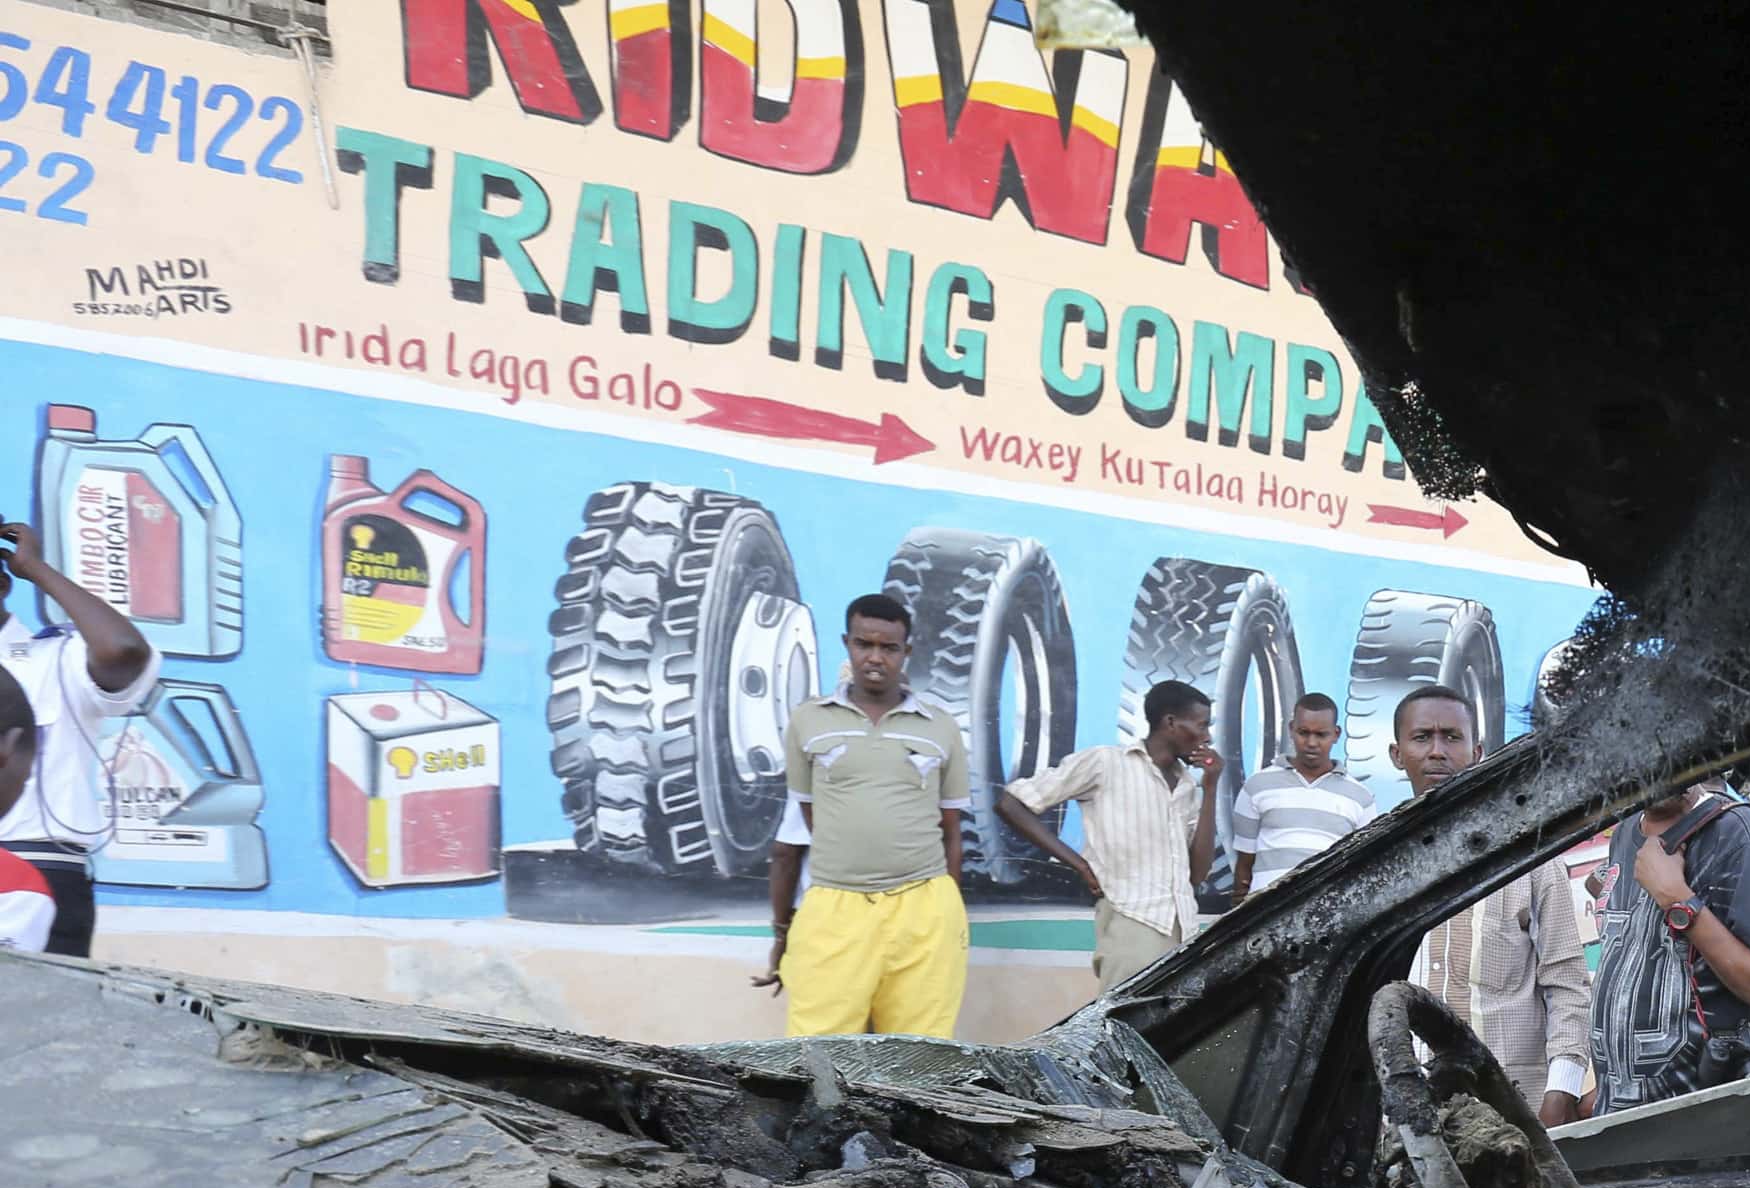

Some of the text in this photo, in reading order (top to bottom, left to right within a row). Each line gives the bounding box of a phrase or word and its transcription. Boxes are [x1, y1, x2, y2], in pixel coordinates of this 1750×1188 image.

[86, 258, 209, 301] MAHDI
[336, 126, 995, 395] TRADING
[156, 288, 232, 317] ARTS
[568, 355, 683, 412] Galo
[1258, 471, 1350, 529] Horay
[105, 494, 128, 605] LUBRICANT
[343, 577, 371, 595] R2
